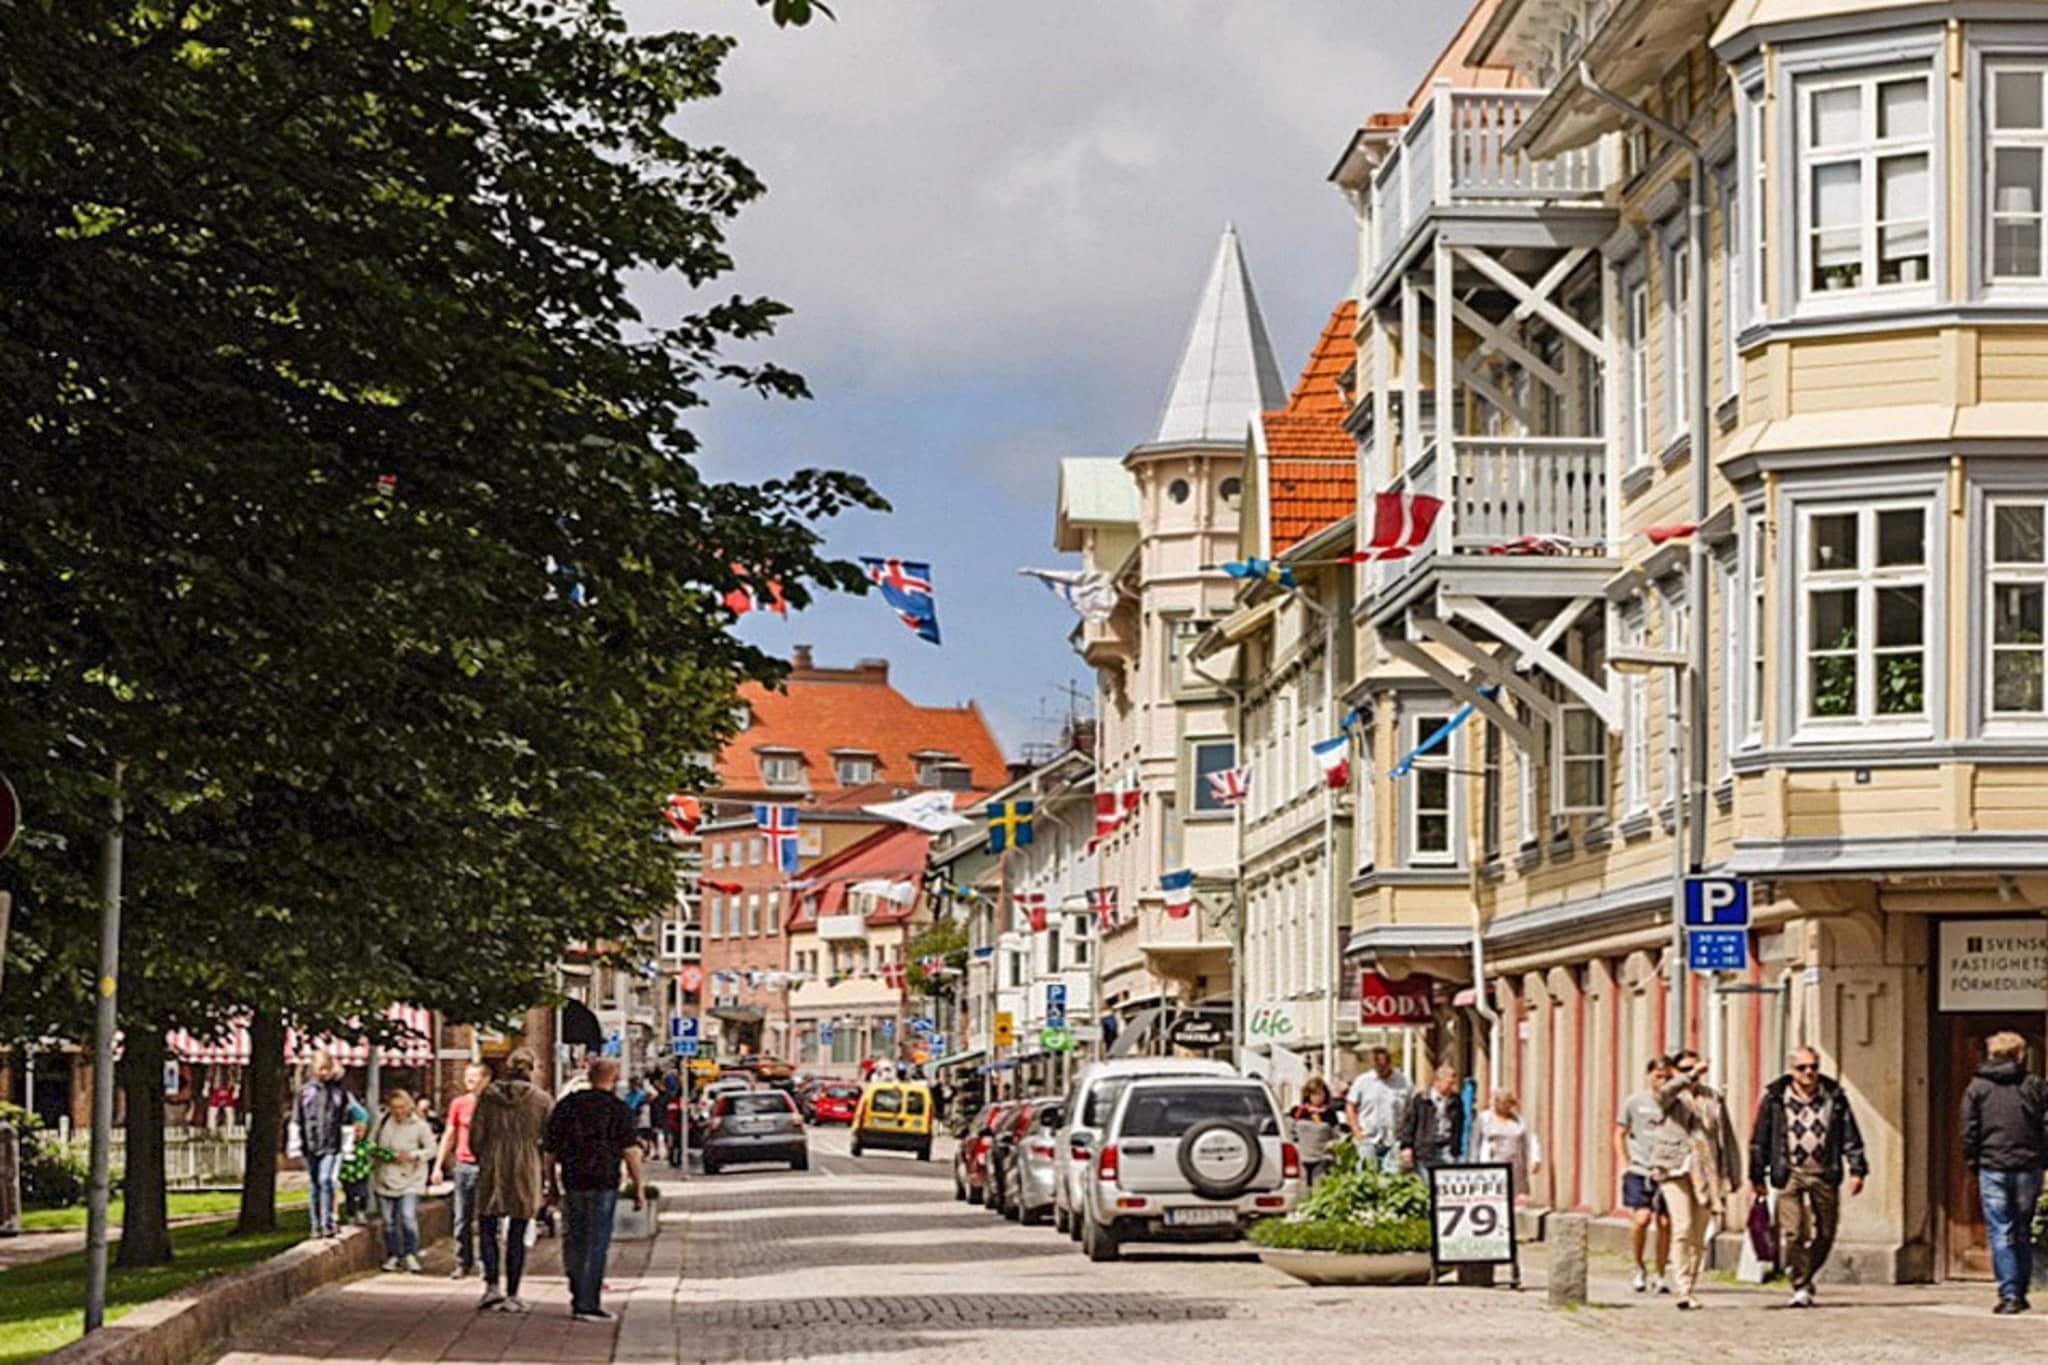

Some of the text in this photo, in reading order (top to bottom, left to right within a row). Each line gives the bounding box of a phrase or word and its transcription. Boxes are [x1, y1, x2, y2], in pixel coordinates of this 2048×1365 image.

[1702, 881, 1735, 923] P
[1361, 995, 1432, 1017] SODA
[678, 1019, 694, 1036] P
[1250, 1007, 1293, 1037] life
